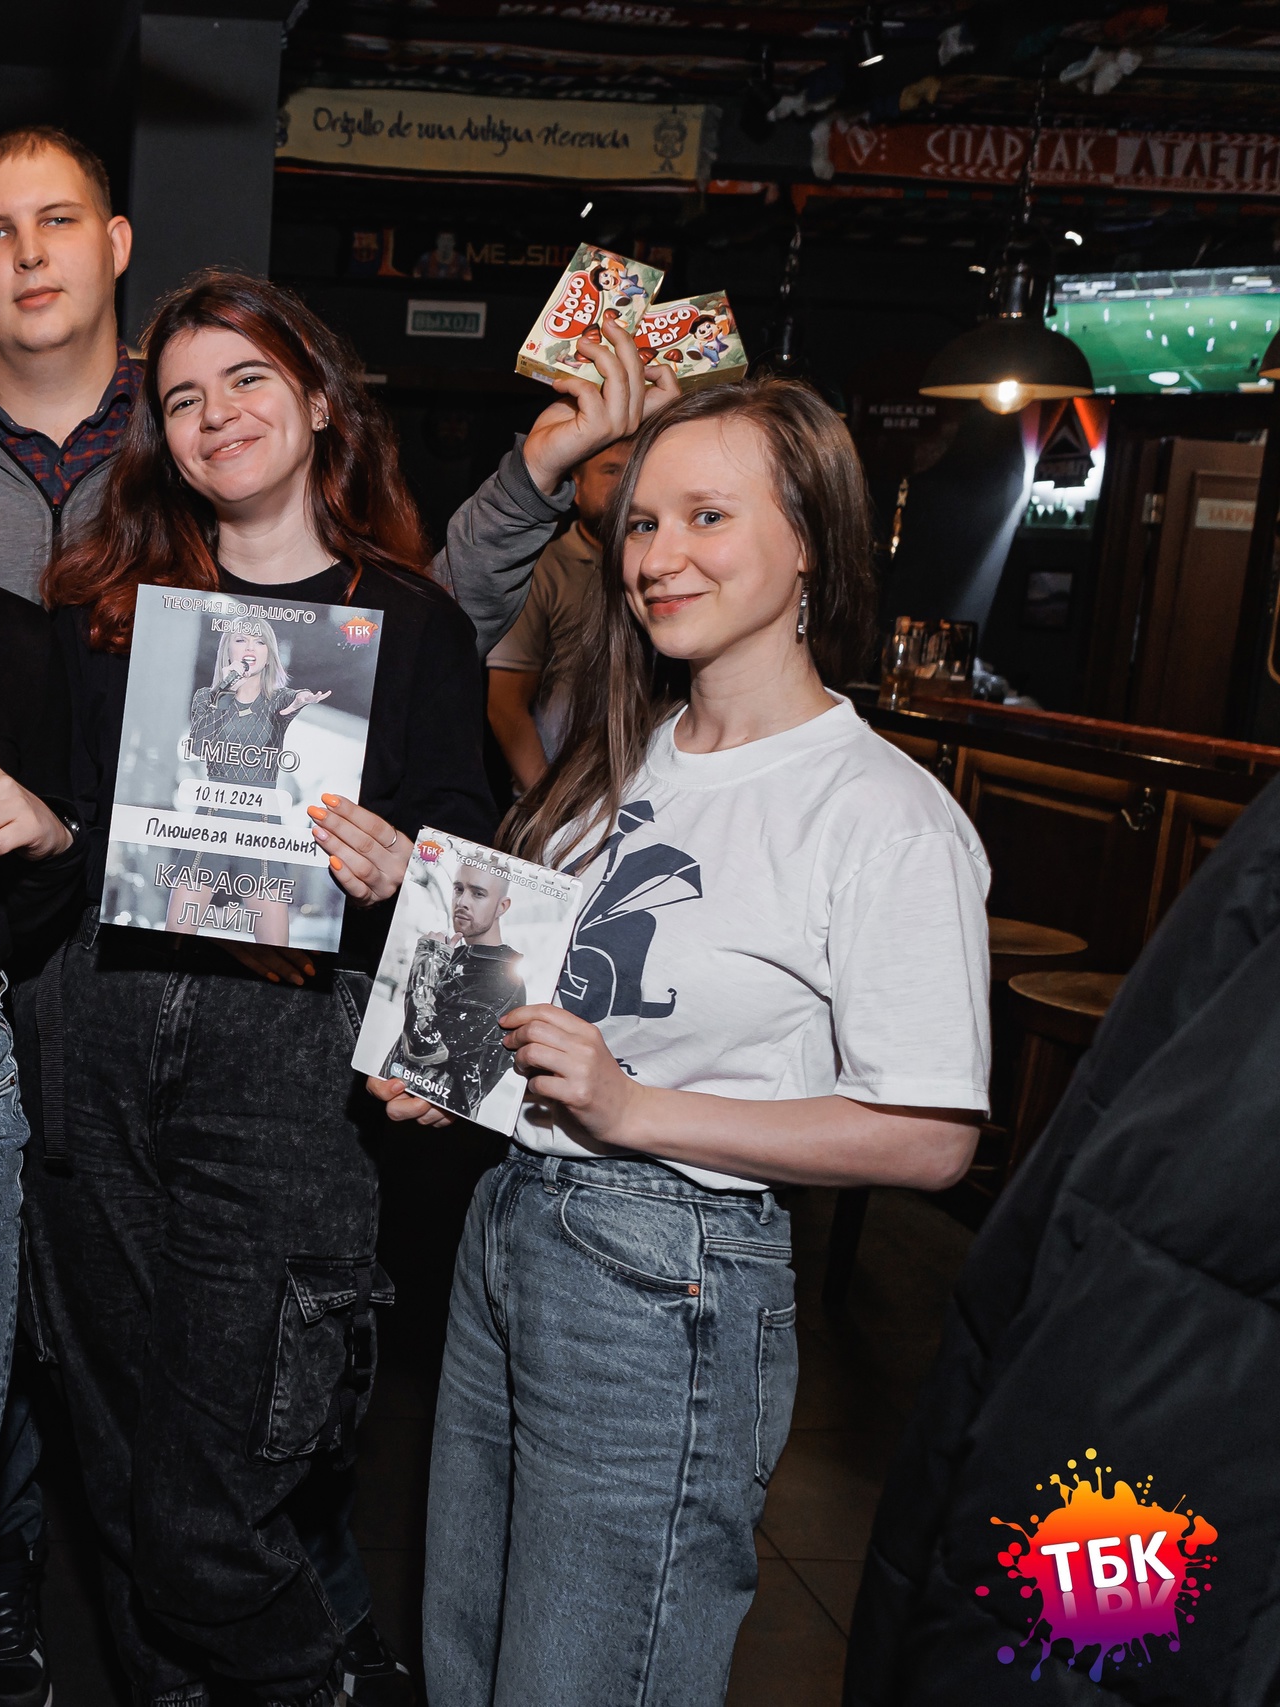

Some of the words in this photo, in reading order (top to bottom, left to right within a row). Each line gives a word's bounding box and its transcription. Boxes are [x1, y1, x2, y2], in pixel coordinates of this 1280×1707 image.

[312, 106, 386, 148] Orgullo
[387, 110, 413, 139] de
[417, 121, 457, 141] una
[535, 121, 631, 149] Herencia
[926, 127, 1097, 173] СПАРТАК
[548, 277, 585, 333] Choco
[414, 313, 478, 332] ВЫХОД
[162, 594, 222, 615] ТЕОРИЯ
[225, 602, 317, 625] БОЛЬШОГО
[210, 617, 263, 637] КВИЗА
[347, 624, 371, 637] ТБК
[181, 737, 194, 761] 1
[199, 739, 301, 773] МЕСТО
[194, 785, 264, 807] 10.11.2024
[145, 817, 228, 844] Плюшевая
[234, 831, 318, 857] наковальня
[422, 844, 438, 856] ТБК
[154, 862, 297, 904] КАРАОКЕ
[455, 854, 488, 872] ТЕОРИЯ
[489, 866, 538, 891] БОЛЬШОГО
[539, 885, 568, 902] КВИЗА
[177, 901, 262, 933] ЛАЙТ
[403, 1069, 451, 1100] BIGQIUZ
